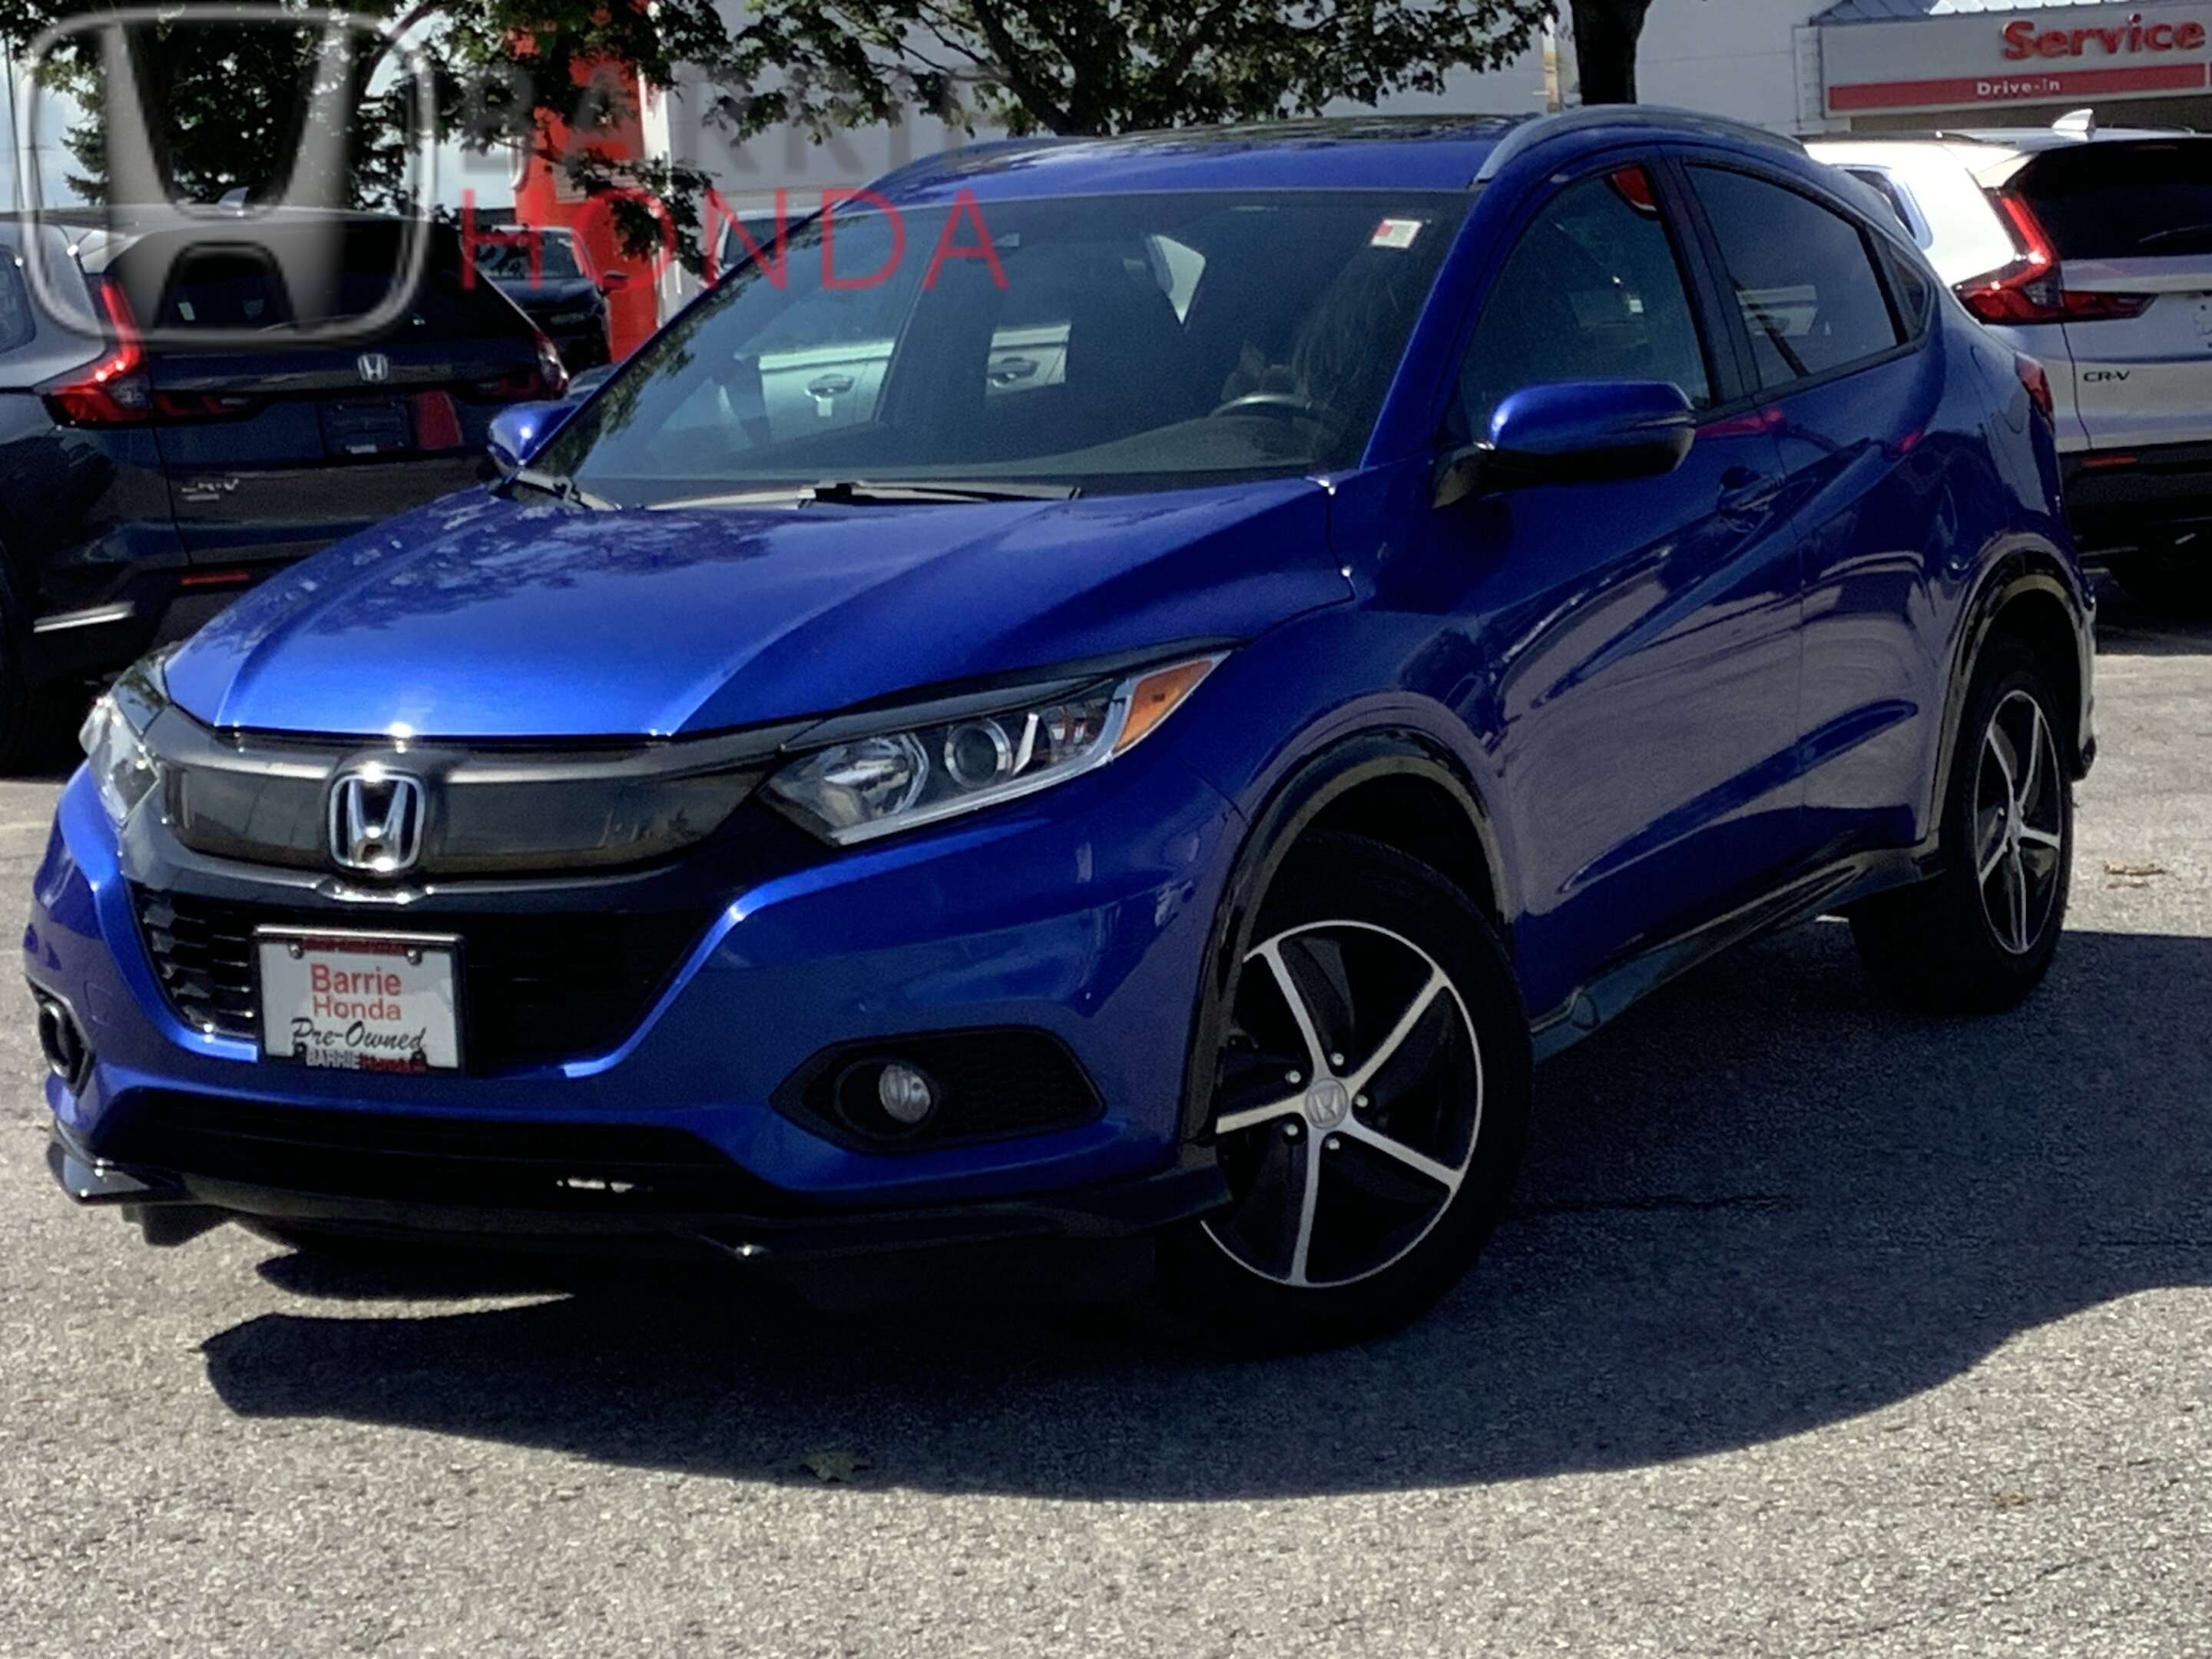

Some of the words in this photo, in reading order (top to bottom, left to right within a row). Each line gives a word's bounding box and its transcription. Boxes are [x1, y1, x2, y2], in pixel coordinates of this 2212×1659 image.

[2003, 13, 2206, 61] Service
[1976, 78, 2061, 96] Drive-in
[2083, 370, 2130, 382] CR-V
[310, 964, 402, 996] Barrie
[313, 996, 402, 1021] Honda
[291, 1017, 427, 1052] Pre-Owned
